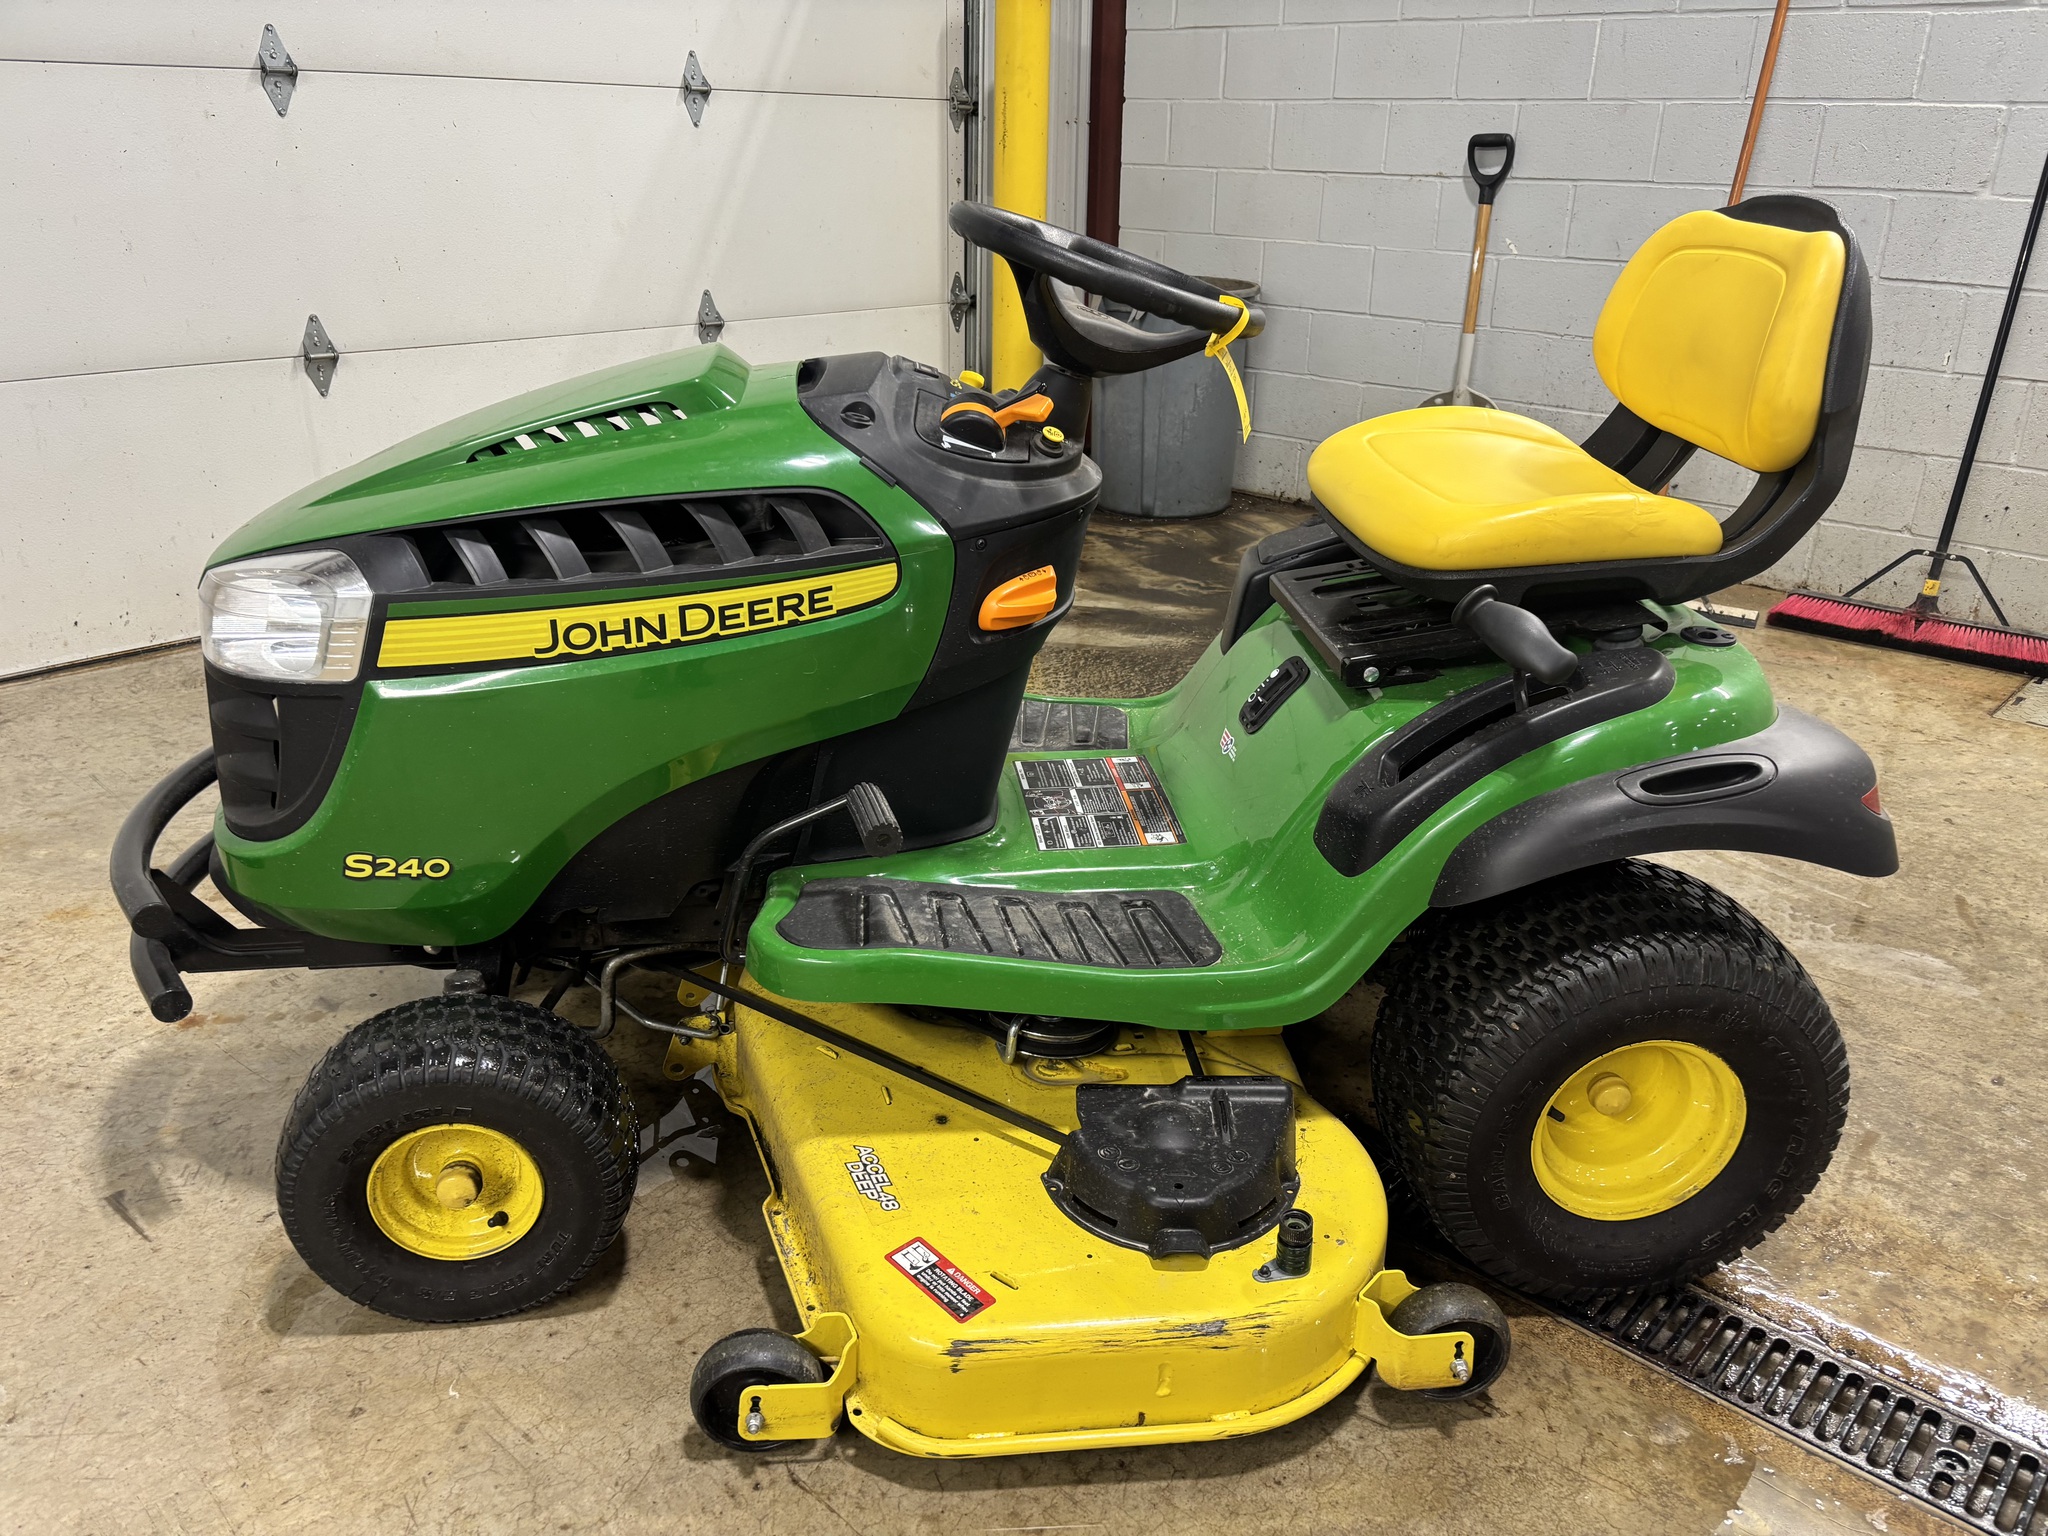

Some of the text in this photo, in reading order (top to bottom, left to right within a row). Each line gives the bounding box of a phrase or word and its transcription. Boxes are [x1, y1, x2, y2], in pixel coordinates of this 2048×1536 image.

[534, 585, 834, 655] JOHN DEERE
[344, 853, 451, 879] S240
[844, 1161, 881, 1202] DEEP
[933, 1268, 973, 1301] ROTATING BLADE
[953, 1272, 981, 1294] DANGER
